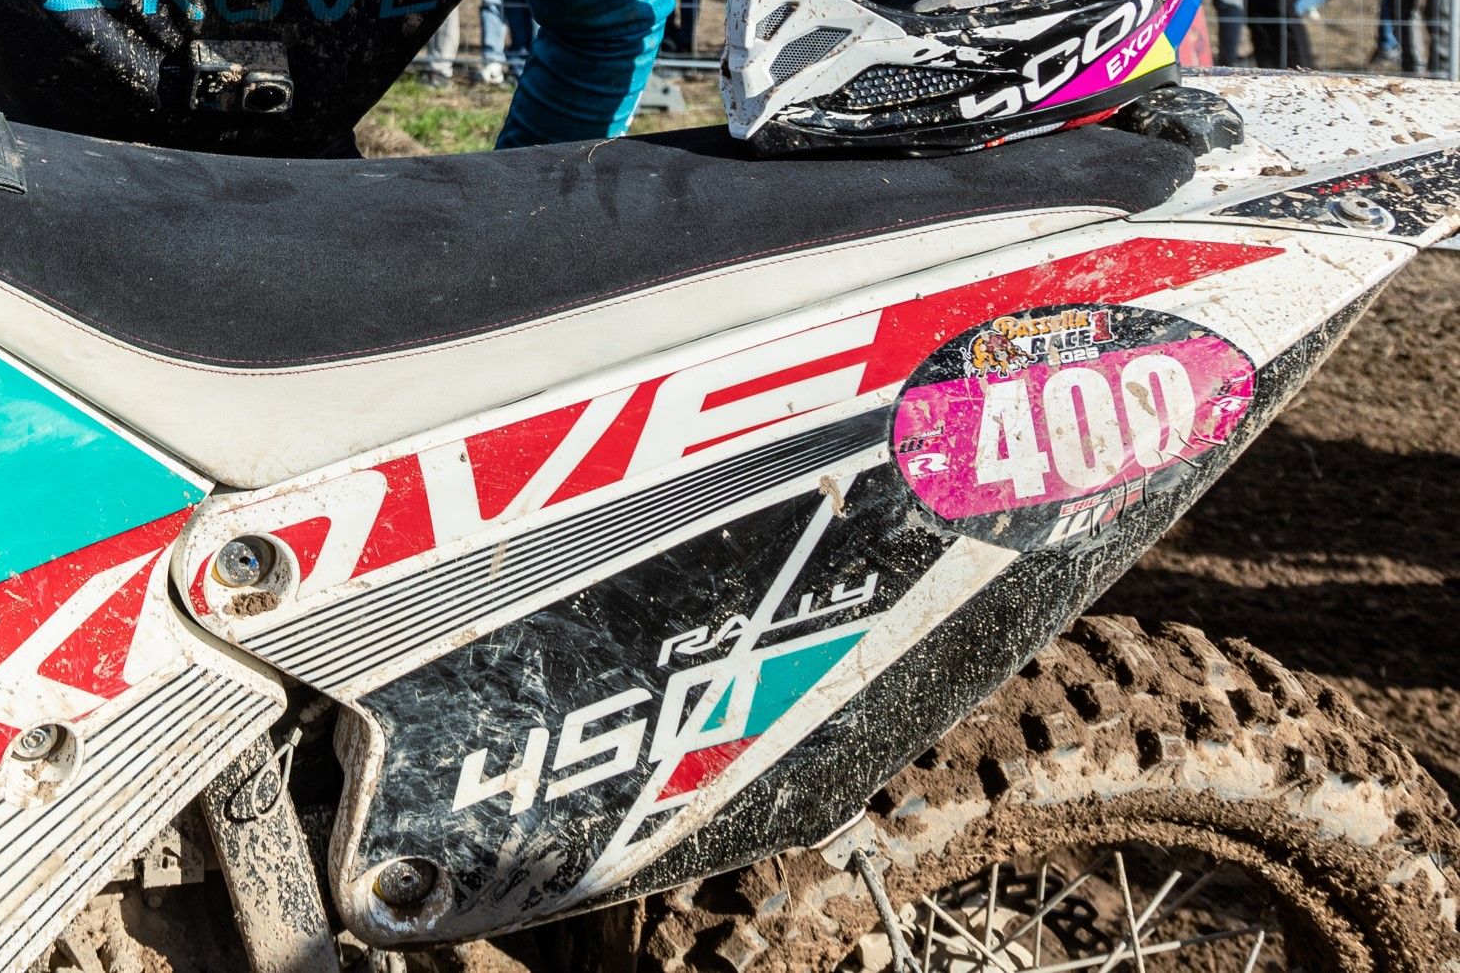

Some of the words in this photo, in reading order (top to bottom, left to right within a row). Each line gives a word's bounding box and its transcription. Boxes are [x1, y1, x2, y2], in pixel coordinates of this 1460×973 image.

[1105, 23, 1153, 81] EXO
[1031, 328, 1091, 355] RACE
[975, 354, 1196, 500] 400
[451, 655, 762, 816] 450
